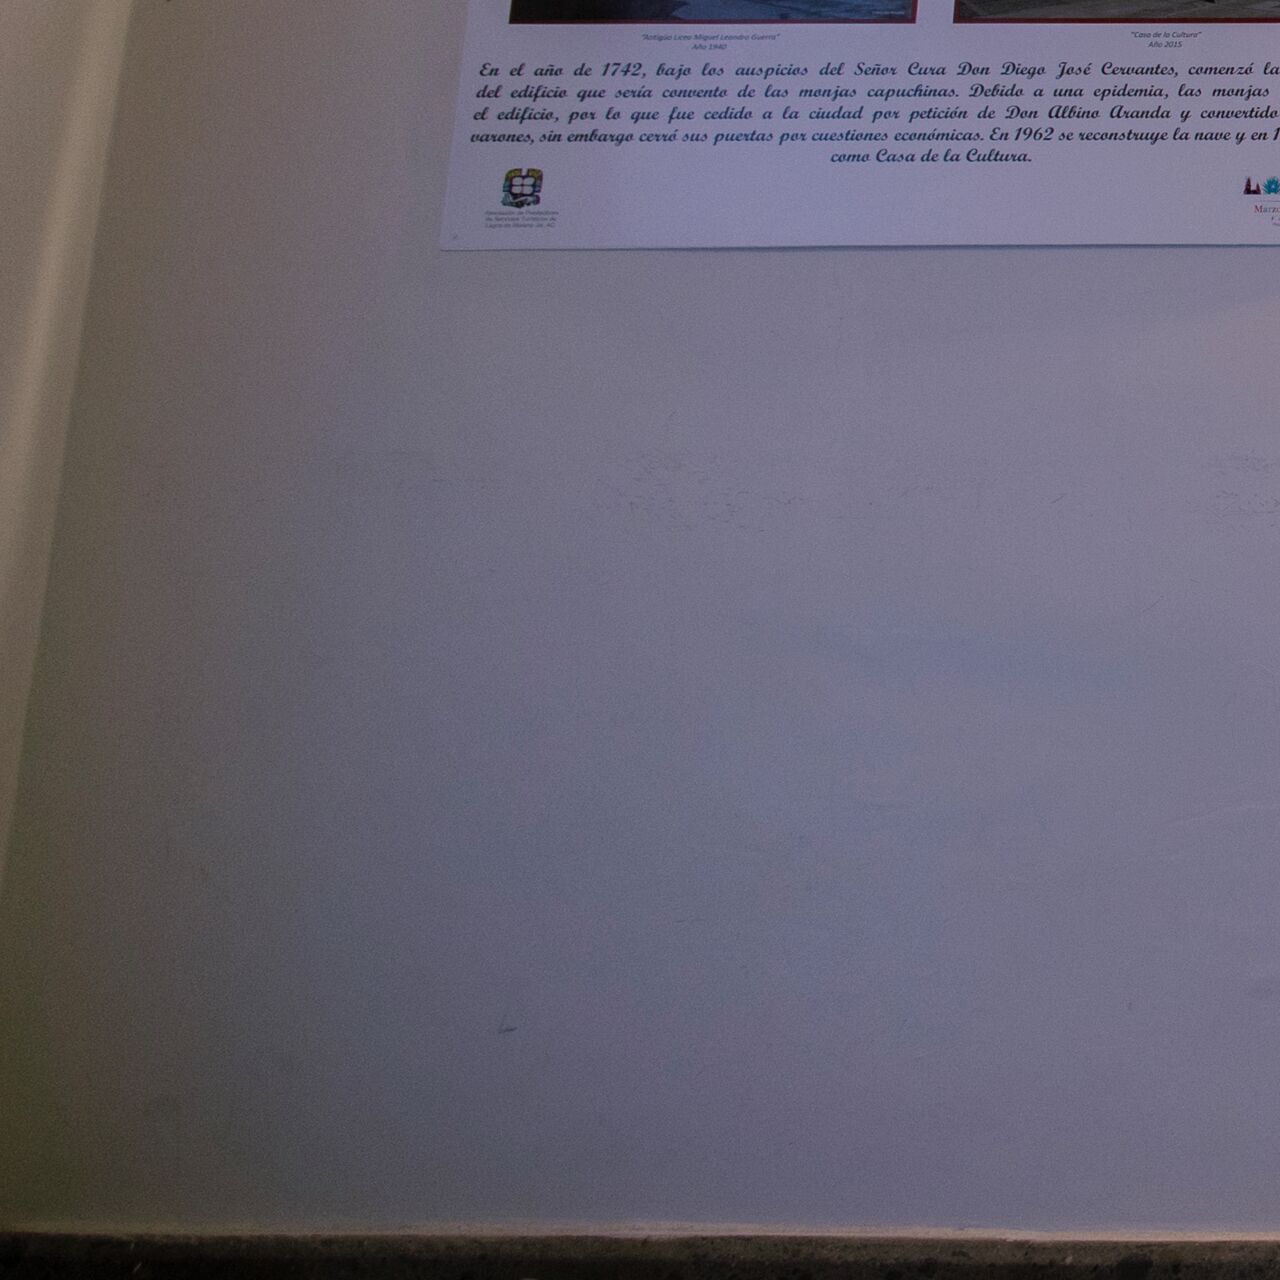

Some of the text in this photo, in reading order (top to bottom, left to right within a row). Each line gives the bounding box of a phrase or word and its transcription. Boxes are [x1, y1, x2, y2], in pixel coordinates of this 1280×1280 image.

[830, 148, 1032, 163] como Casa de la Cultura.
